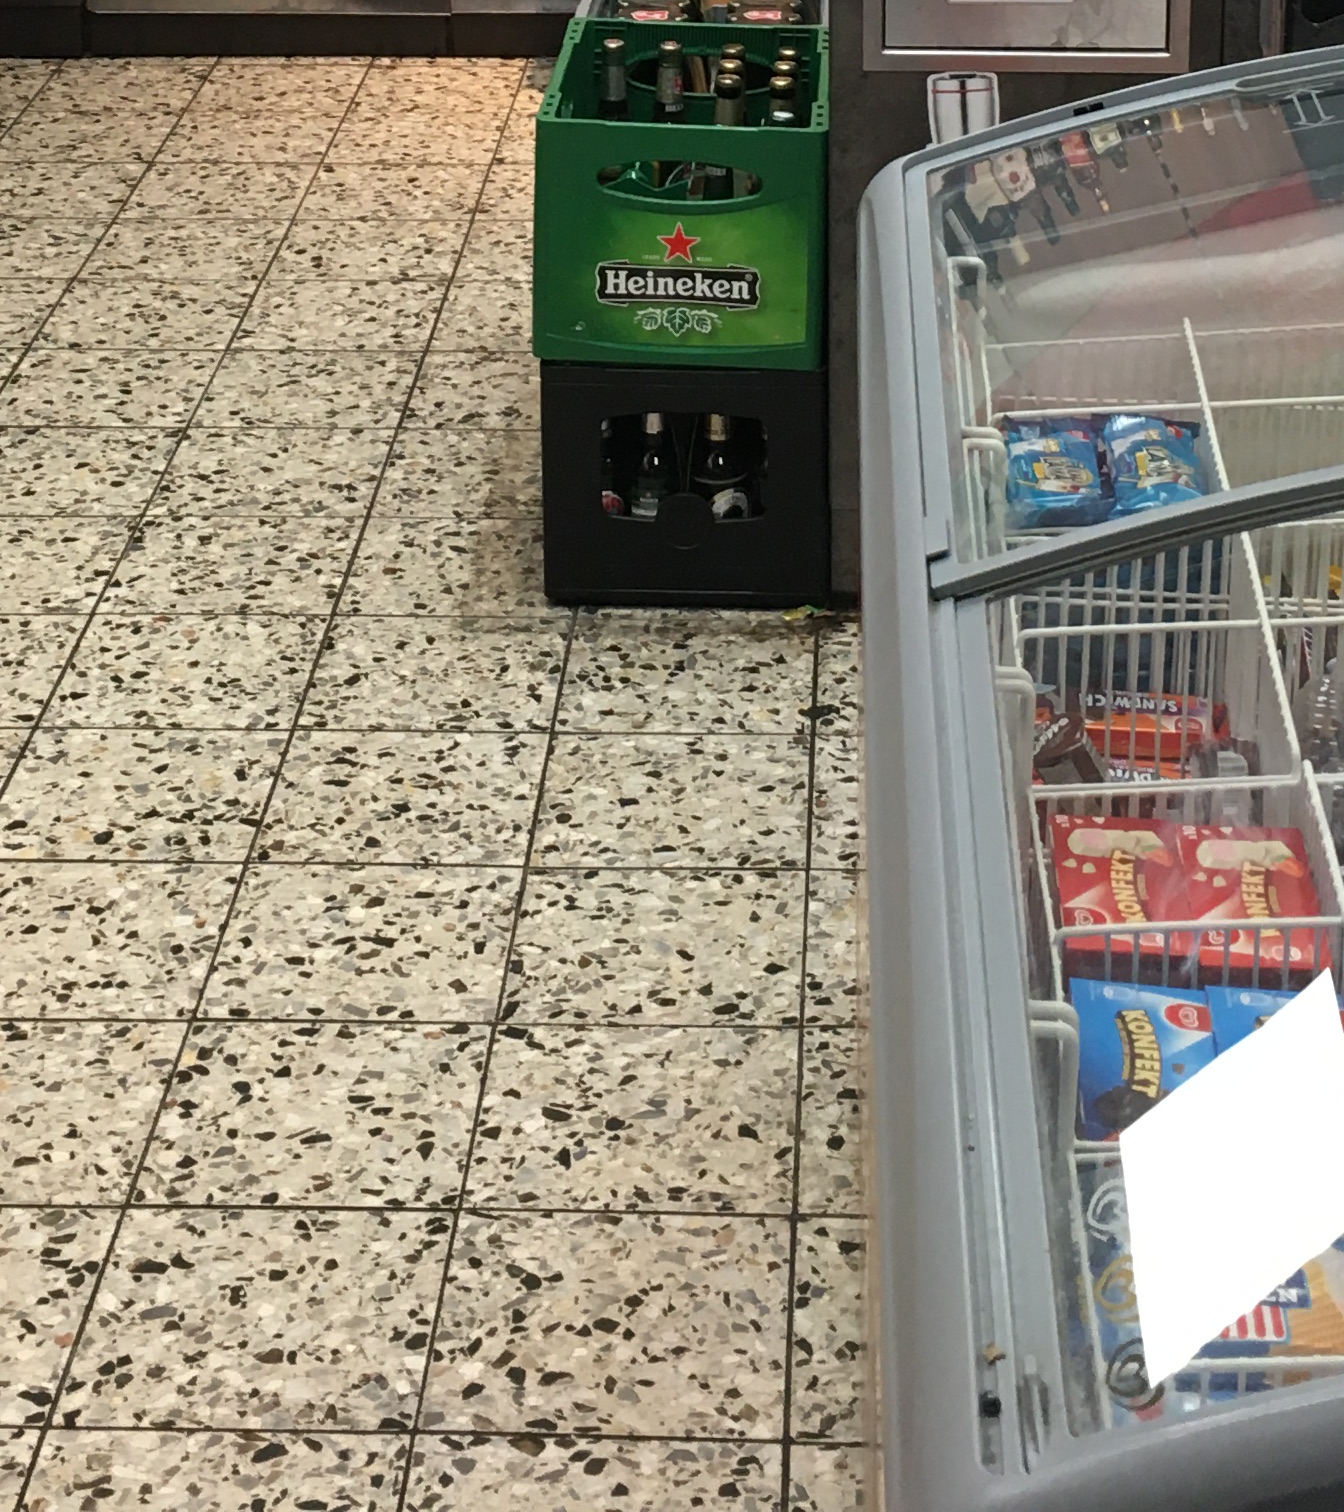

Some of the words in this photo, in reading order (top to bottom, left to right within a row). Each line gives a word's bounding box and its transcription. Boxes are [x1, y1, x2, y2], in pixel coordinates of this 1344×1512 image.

[604, 268, 752, 302] Heineken
[1109, 849, 1147, 924] KONFEKT
[1122, 1008, 1163, 1099] KONFEKT
